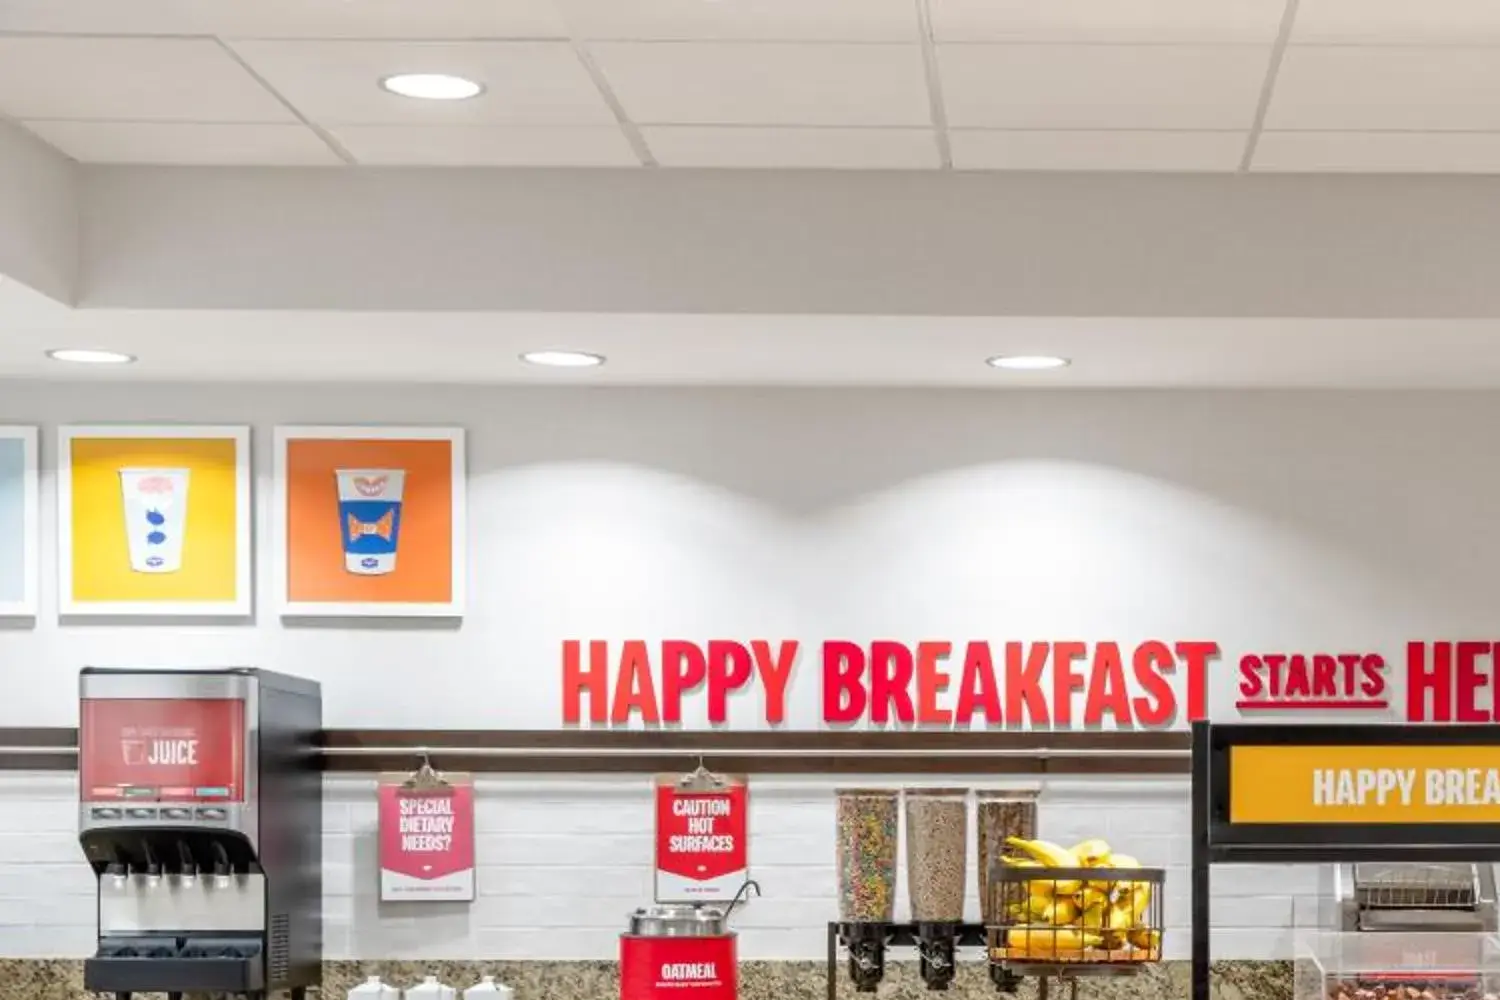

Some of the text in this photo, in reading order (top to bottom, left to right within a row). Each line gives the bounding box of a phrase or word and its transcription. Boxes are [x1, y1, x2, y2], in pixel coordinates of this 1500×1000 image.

[562, 639, 799, 724] HAPPY
[823, 640, 1219, 726] BREAKFAST
[1238, 653, 1386, 698] STARTS
[148, 739, 199, 766] JUICE
[1313, 767, 1416, 806] HAPPY
[400, 797, 454, 815] SPECIAL
[672, 798, 731, 817] CAUTION
[400, 815, 454, 833] DIETARY
[688, 817, 715, 834] HOT
[402, 834, 452, 851] NEEDS?
[669, 835, 734, 853] SURFACES
[661, 961, 718, 980] OATMEAL
